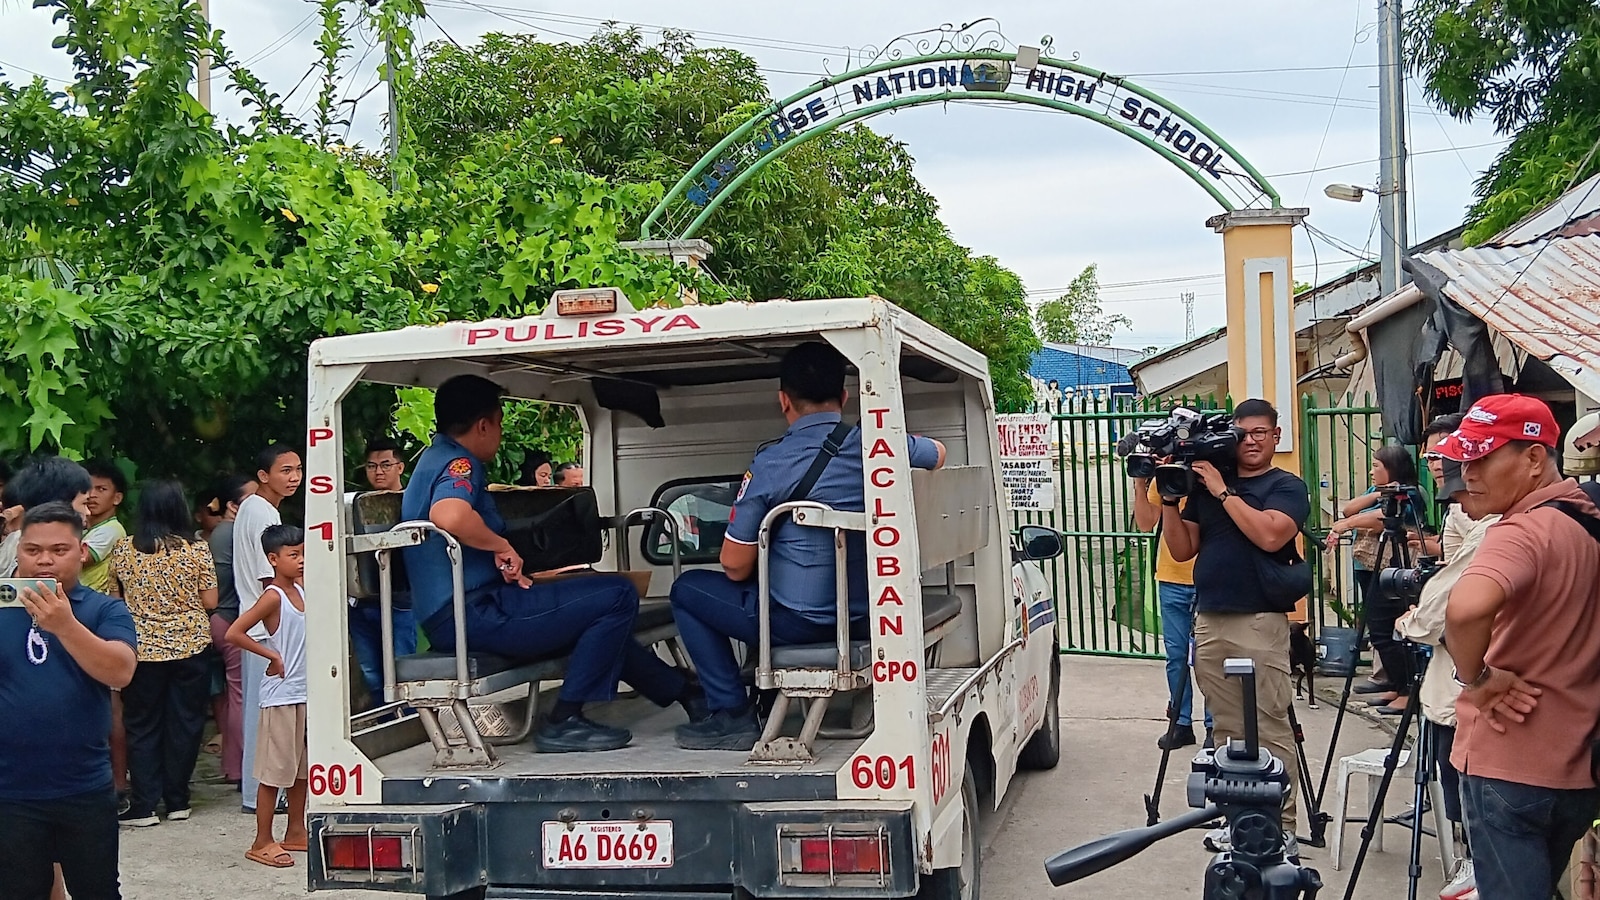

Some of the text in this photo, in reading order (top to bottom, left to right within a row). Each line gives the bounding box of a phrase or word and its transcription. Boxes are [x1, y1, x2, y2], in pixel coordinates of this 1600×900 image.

[755, 97, 829, 151] JOSE
[852, 65, 997, 104] NATIONAL
[1025, 69, 1097, 104] HIGH
[1120, 97, 1222, 180] SCHOOL
[467, 314, 701, 345] PULISYA
[1018, 423, 1048, 435] ENTRY
[868, 408, 903, 636] TACLOBAN
[873, 661, 917, 683] CPO
[309, 763, 362, 796] 601
[851, 755, 915, 790] 601
[931, 727, 951, 806] 601
[558, 833, 658, 861] A6 D669
